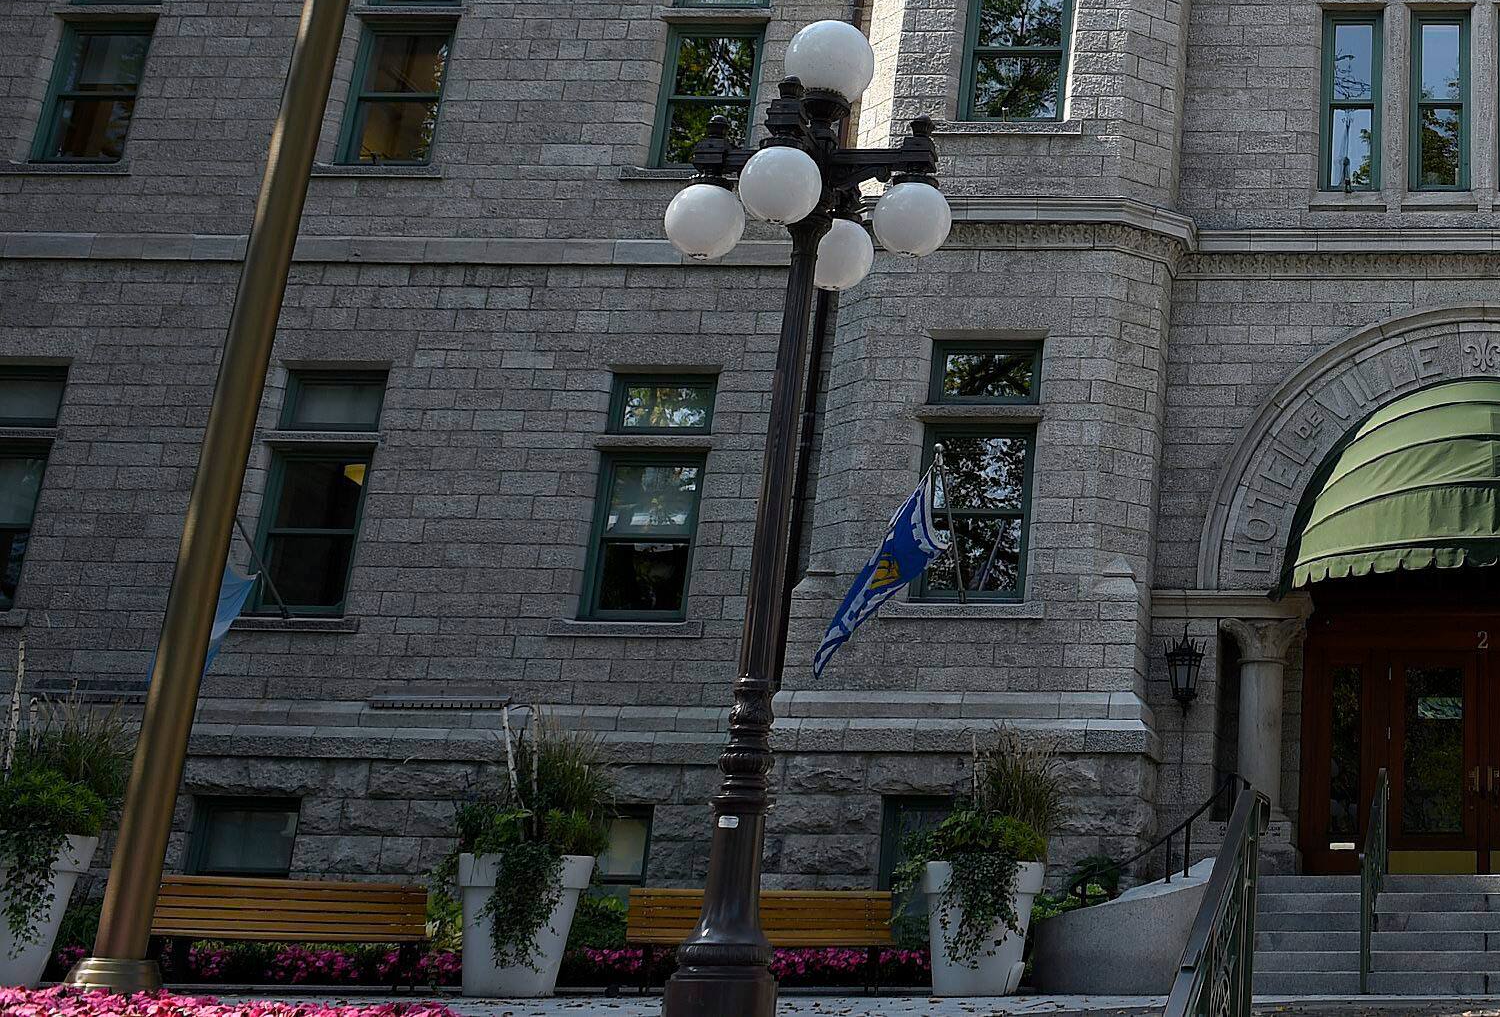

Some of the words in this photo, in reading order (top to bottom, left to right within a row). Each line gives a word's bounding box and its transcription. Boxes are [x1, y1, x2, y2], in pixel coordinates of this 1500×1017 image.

[1294, 409, 1325, 441] DE
[1314, 345, 1444, 420] VILLE
[1477, 630, 1489, 649] 2
